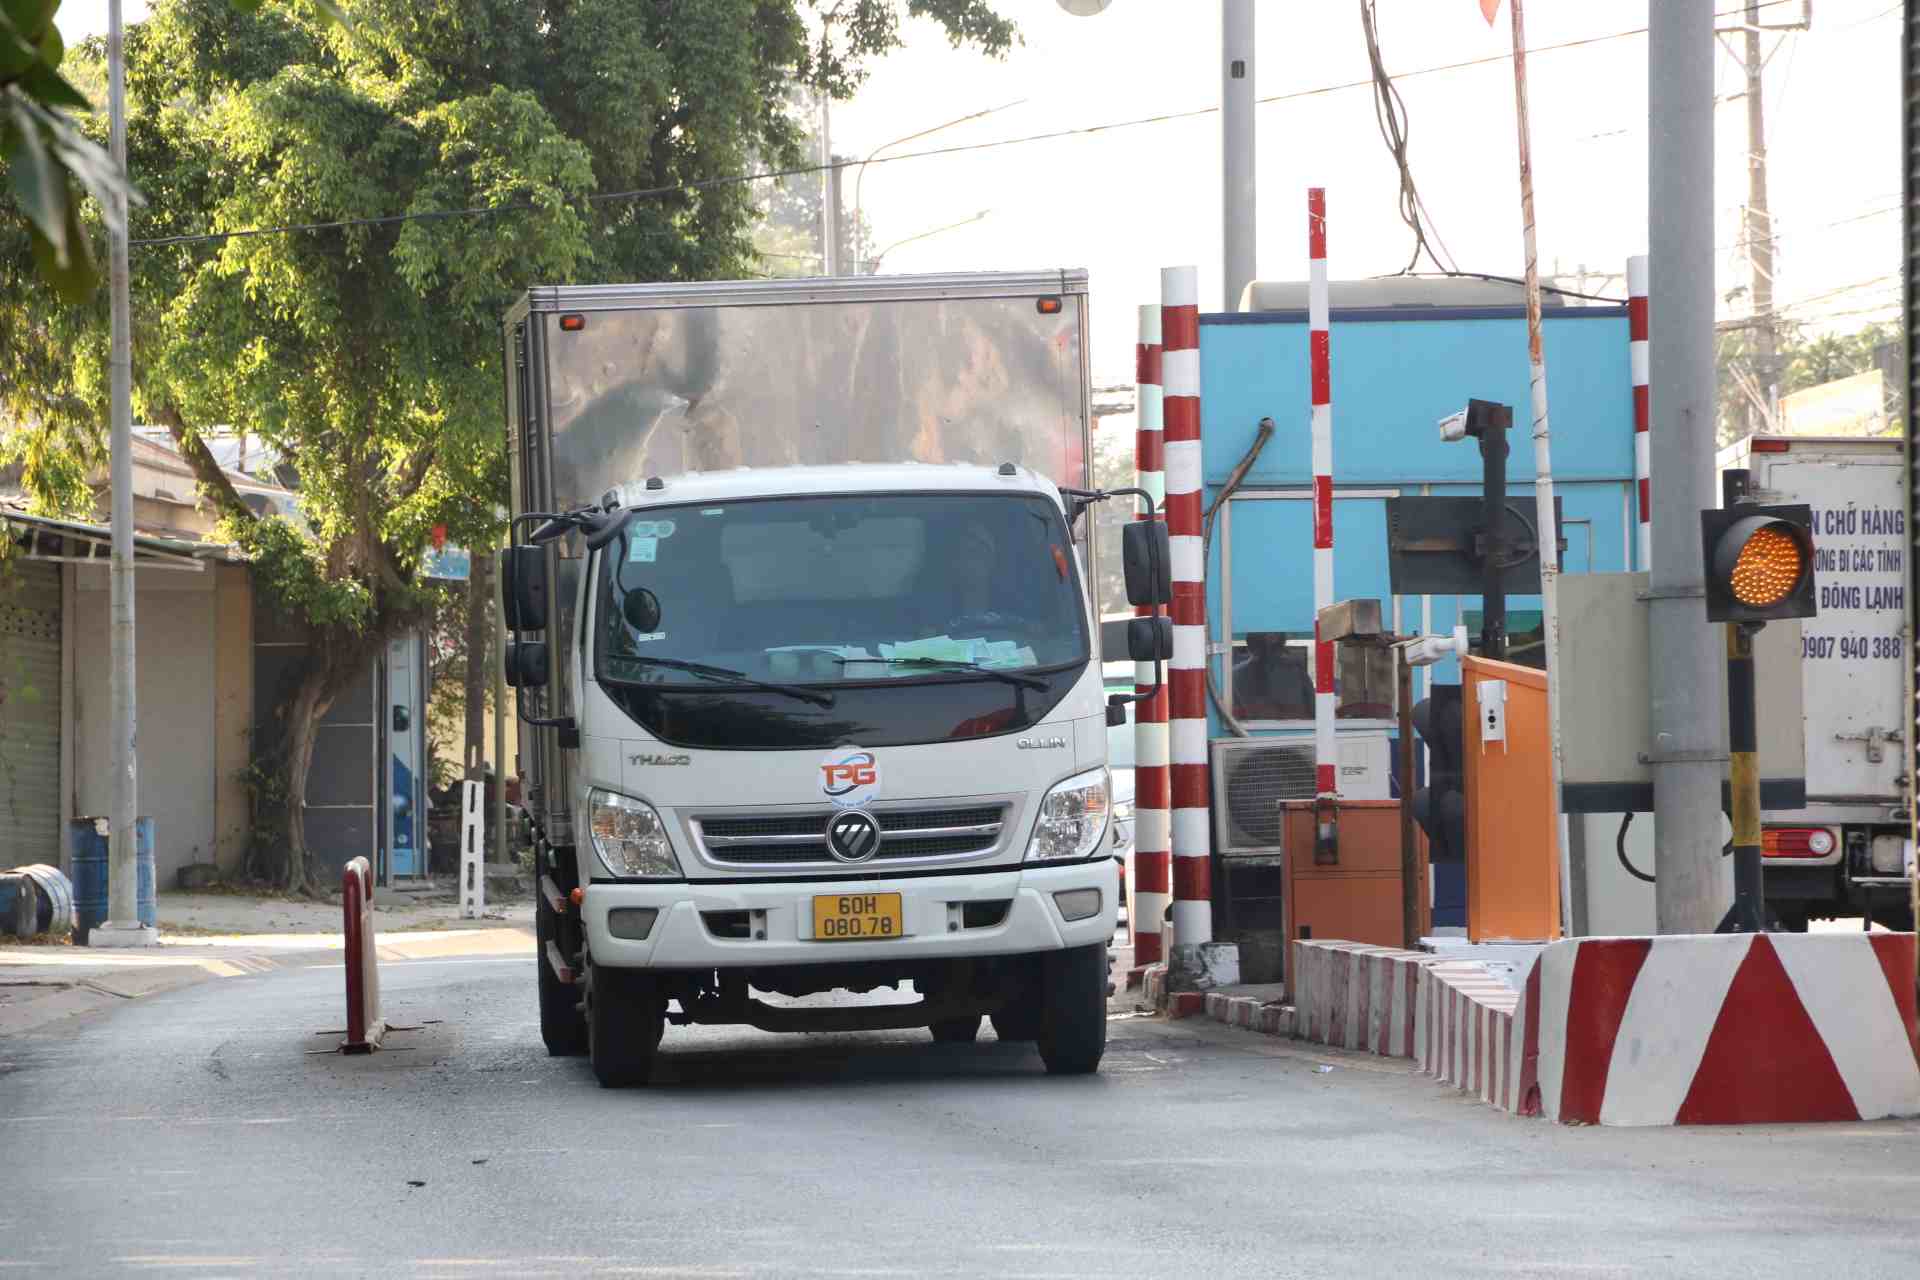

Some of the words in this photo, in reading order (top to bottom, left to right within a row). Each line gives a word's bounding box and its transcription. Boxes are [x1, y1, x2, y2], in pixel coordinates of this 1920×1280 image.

[1861, 505, 1904, 535] HÀNG
[1853, 545, 1874, 572] CÁC
[1821, 581, 1860, 609] ĐÔNG
[1865, 586, 1904, 614] LẠNH
[1840, 636, 1868, 658] 940
[1872, 636, 1901, 658] 388
[821, 763, 876, 788] TPG
[839, 896, 876, 914] 60H
[824, 916, 892, 936] 080.78
